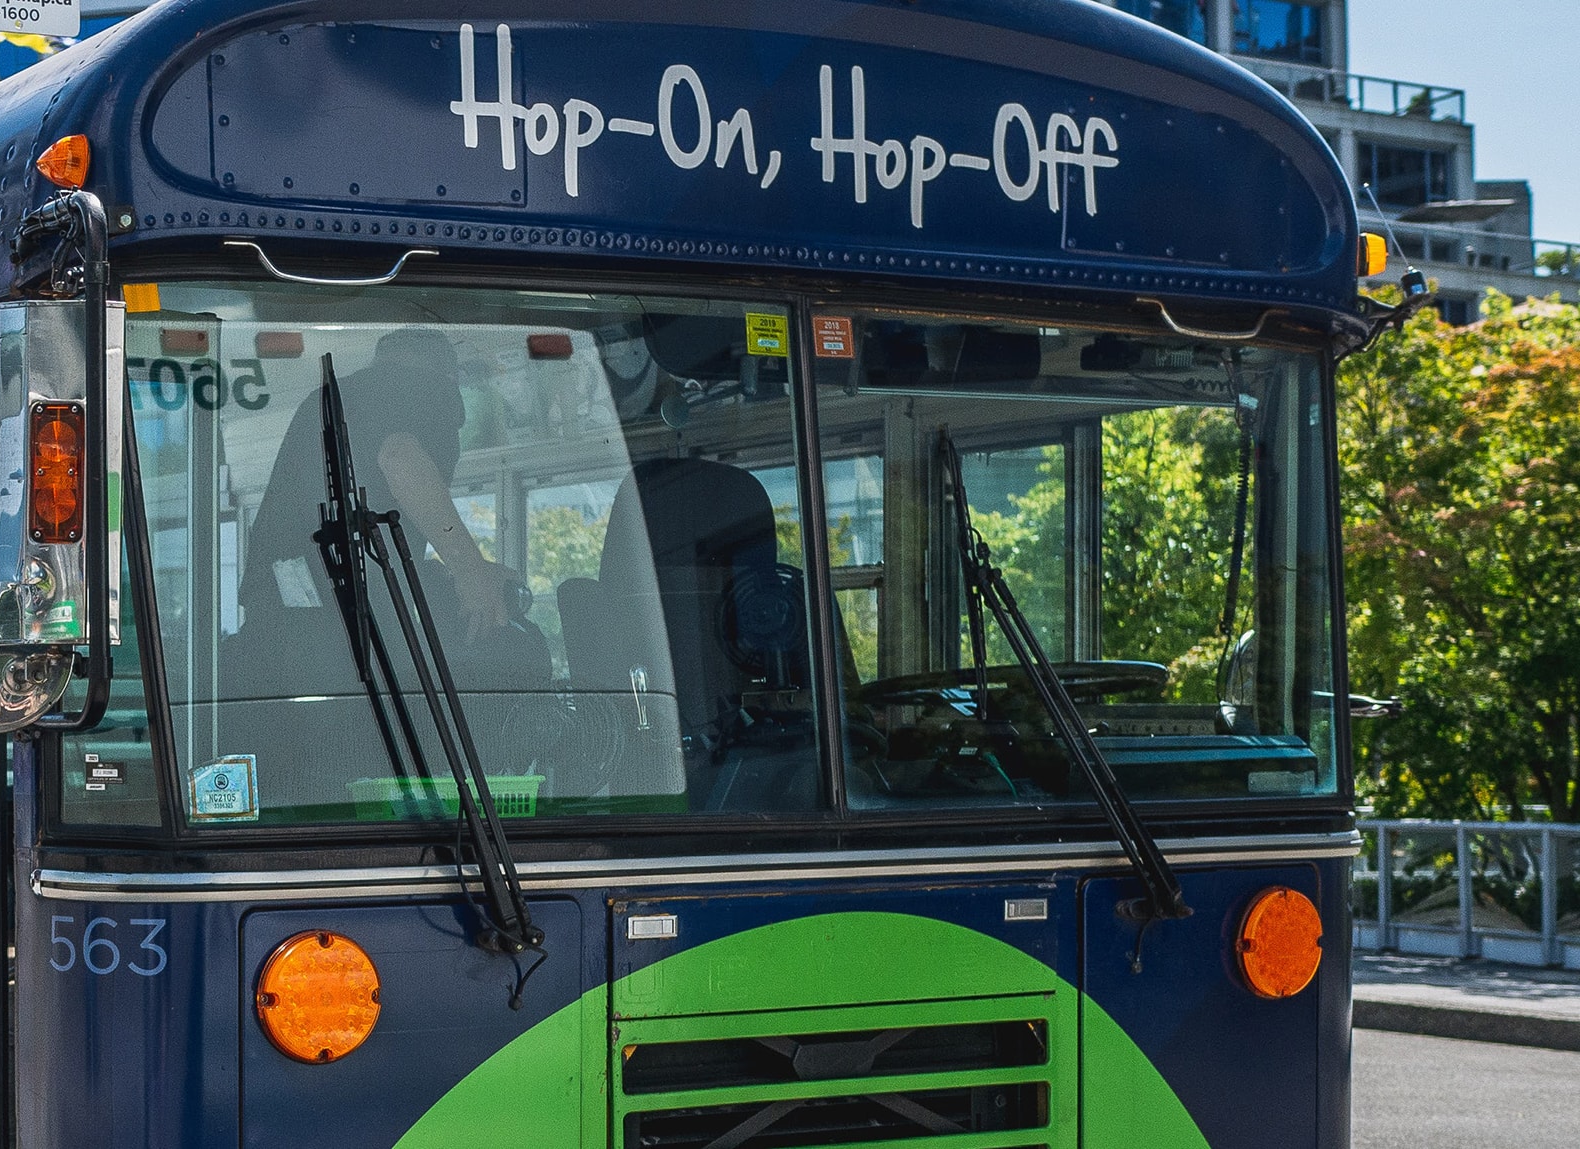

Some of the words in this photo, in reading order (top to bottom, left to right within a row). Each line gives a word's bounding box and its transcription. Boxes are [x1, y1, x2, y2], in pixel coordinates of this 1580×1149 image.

[450, 23, 782, 198] Hop-On,
[810, 64, 1119, 229] Hop-Off
[208, 793, 237, 802] NC2105
[49, 915, 169, 977] 563
